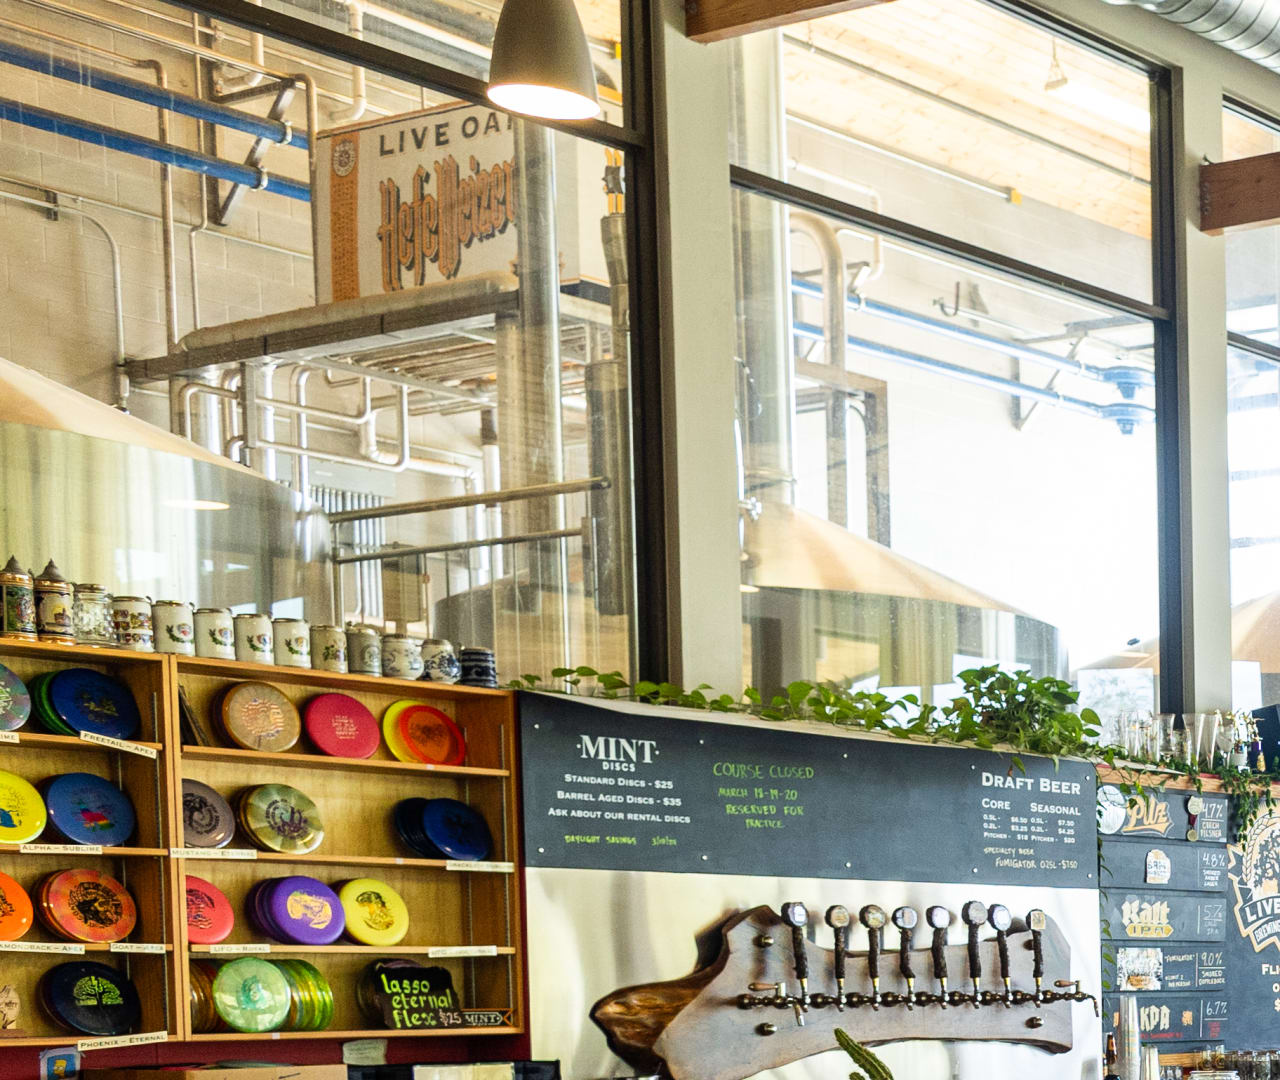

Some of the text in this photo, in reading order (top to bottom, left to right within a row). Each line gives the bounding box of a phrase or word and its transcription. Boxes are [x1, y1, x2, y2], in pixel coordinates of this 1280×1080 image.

[379, 122, 450, 157] LIVE
[83, 732, 155, 756] FREETAIL APEX
[580, 734, 658, 764] MINT
[602, 762, 636, 772] DISCS
[712, 762, 815, 779] COURSE CLOSED
[564, 774, 674, 789] STANDARD DISCS $25
[981, 772, 1081, 795] DRAFT BEER
[556, 791, 682, 807] BARREL AGED DISCS $35
[718, 787, 748, 798] MARCH
[725, 804, 805, 816] RESERVED FOR
[981, 798, 1011, 810] CORE
[1030, 802, 1081, 816] SEASONAL
[548, 807, 691, 824] ASK ABOUT OUR RENTAL DISCS
[1030, 835, 1055, 843] PITCHER
[22, 844, 101, 853] ALPHA SUBLIME
[1132, 926, 1164, 935] IPA
[1254, 919, 1280, 942] BREWING
[380, 973, 431, 995] lasso
[391, 988, 454, 1009] eternal
[438, 1009, 462, 1027] $25
[80, 1034, 166, 1049] PHOENIX ETERNAL
